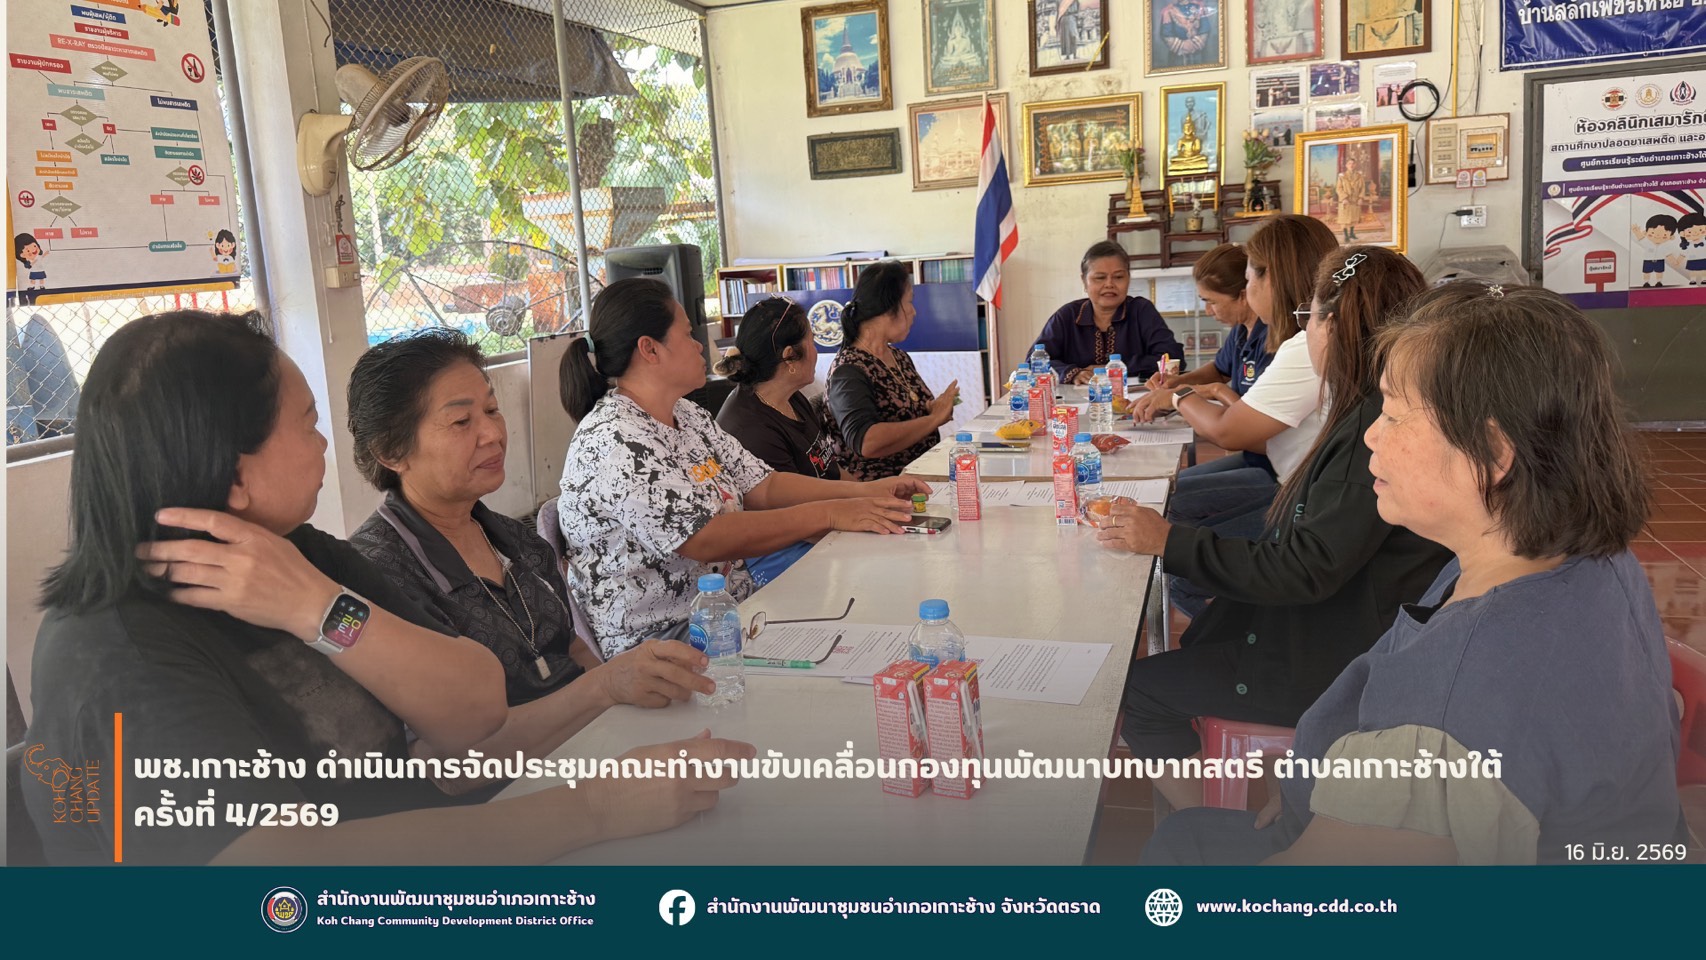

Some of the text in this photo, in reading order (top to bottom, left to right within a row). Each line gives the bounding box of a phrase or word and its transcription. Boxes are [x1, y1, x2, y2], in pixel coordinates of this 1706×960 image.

[1551, 135, 1675, 152] สถานศึกษาปลอดยาเสพติด
